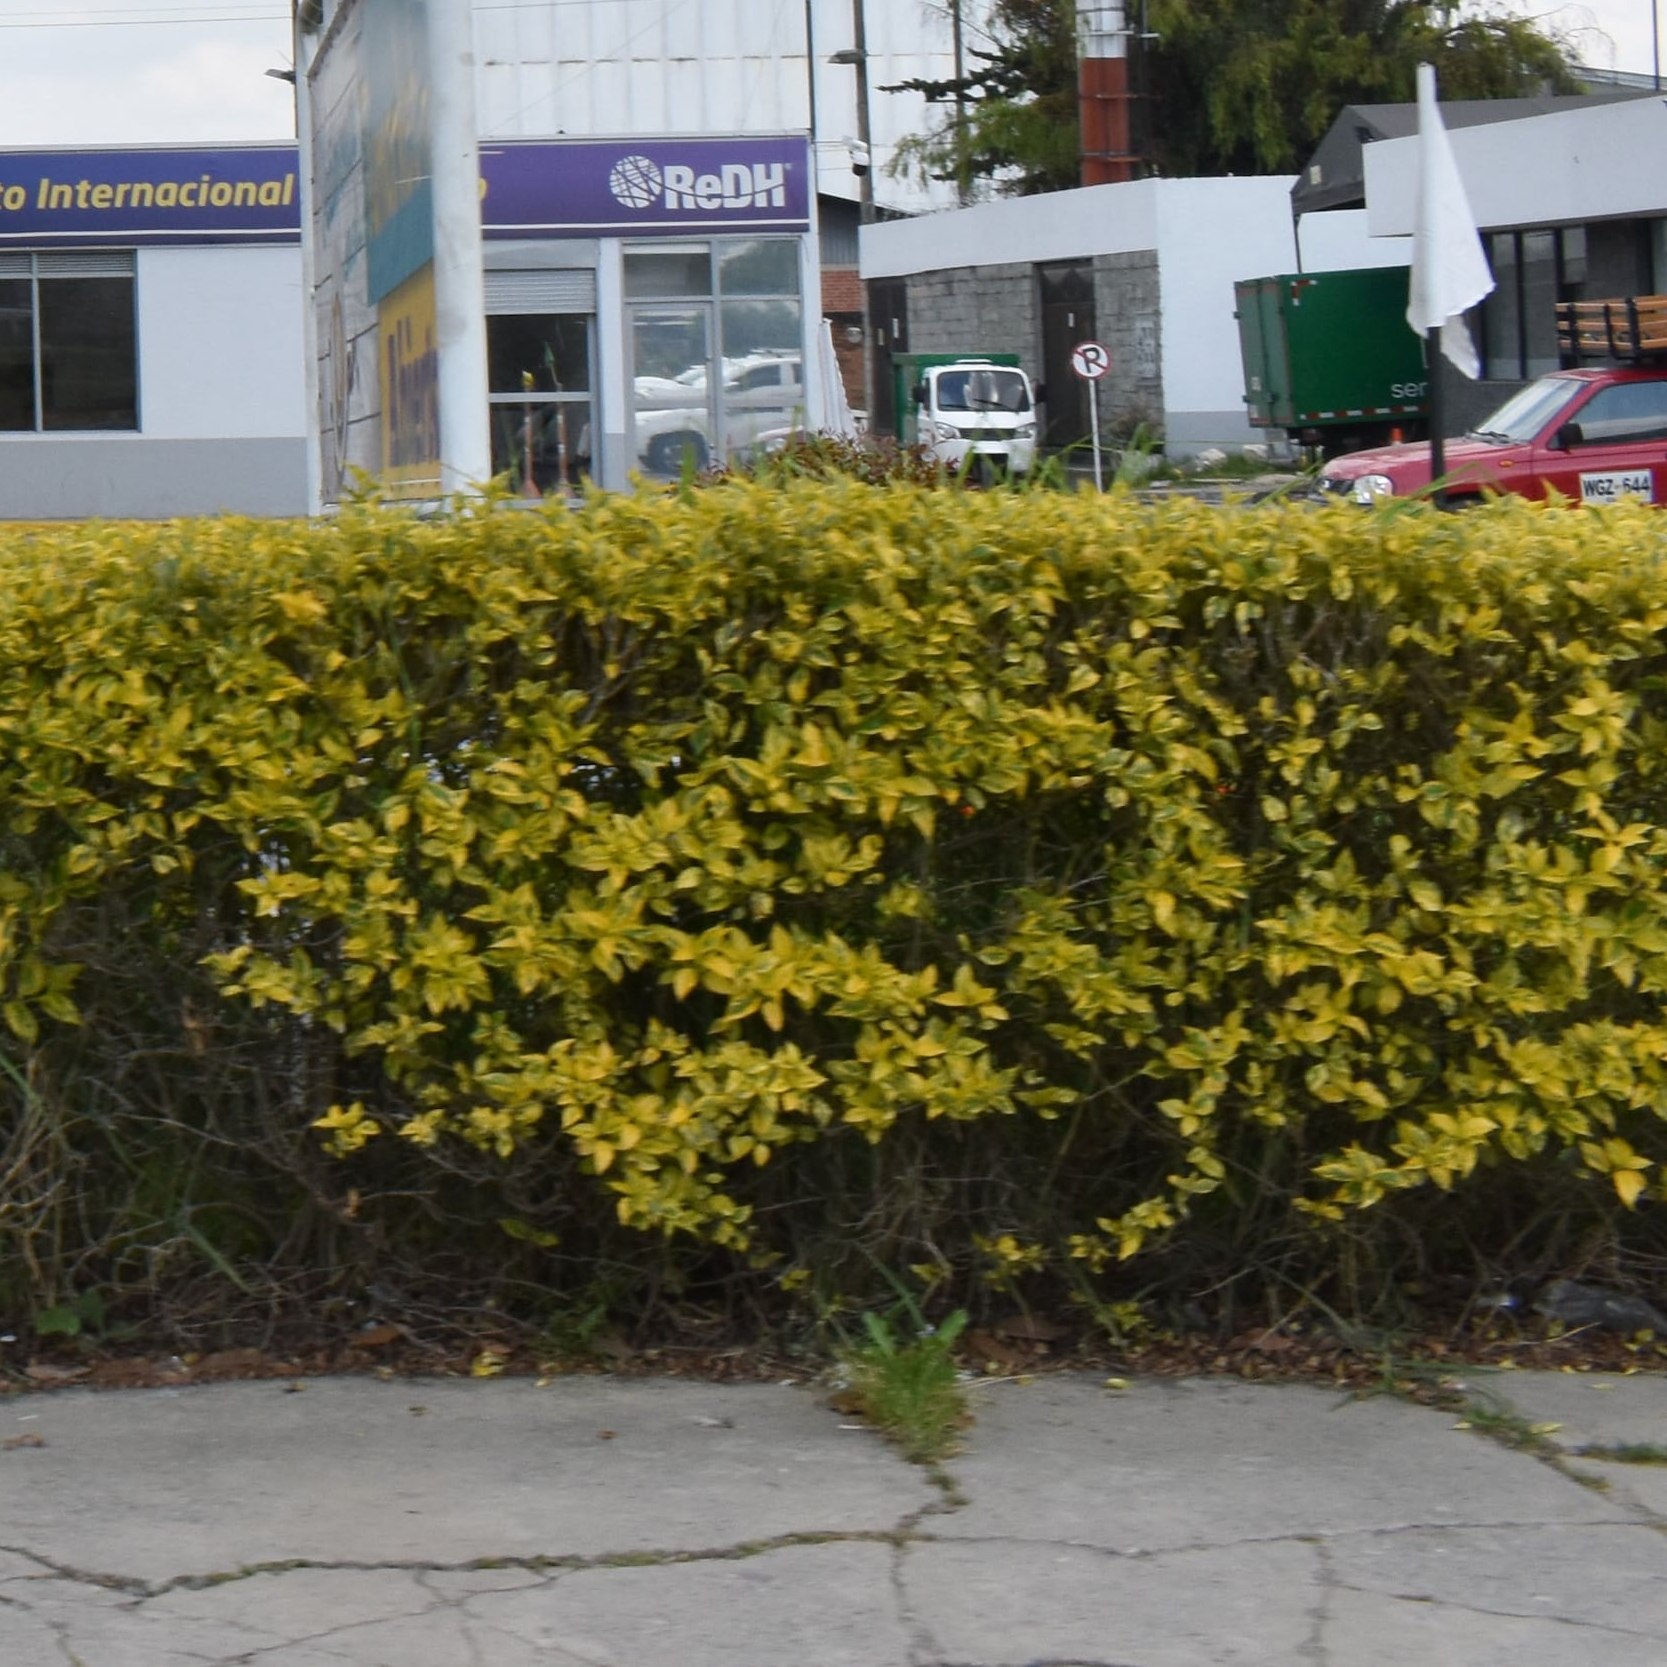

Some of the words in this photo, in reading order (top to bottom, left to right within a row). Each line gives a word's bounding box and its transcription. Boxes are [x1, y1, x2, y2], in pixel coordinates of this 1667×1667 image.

[37, 173, 295, 210] Internacional
[664, 163, 786, 210] ReDH
[1390, 381, 1428, 399] ser
